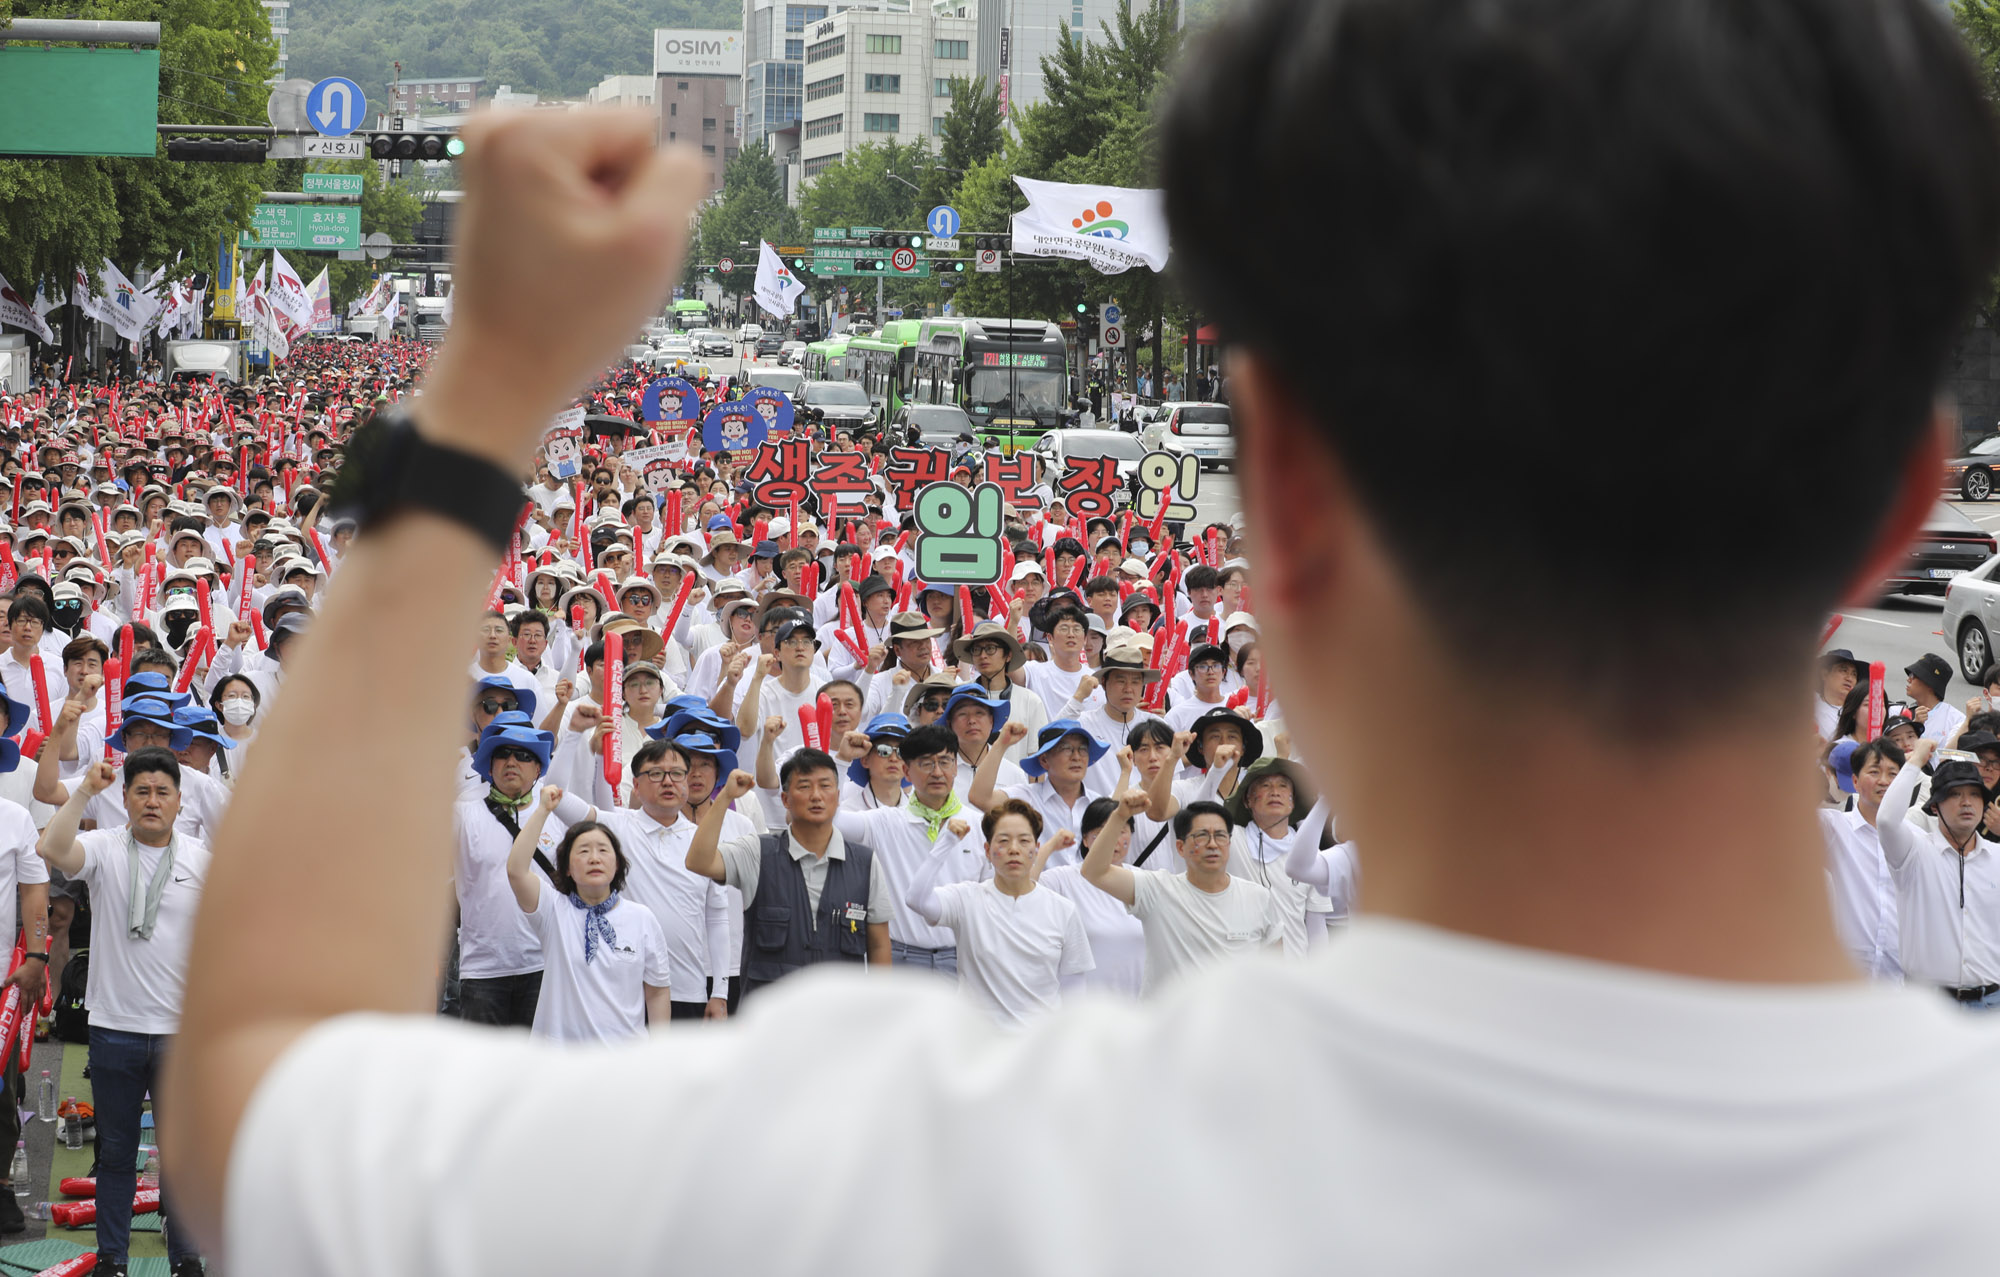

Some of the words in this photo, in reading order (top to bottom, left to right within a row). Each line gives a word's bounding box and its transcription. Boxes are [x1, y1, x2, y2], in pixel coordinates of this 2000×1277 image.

[665, 39, 721, 55] OSIM
[322, 142, 359, 155] 신호시
[306, 178, 360, 190] 정부서울청사
[254, 208, 286, 219] 수색역
[313, 212, 347, 224] 효자동
[252, 218, 278, 226] Susaek
[280, 218, 293, 226] Stn
[308, 224, 350, 234] Hyoja-dong
[816, 229, 846, 238] 경복궁역
[935, 241, 957, 249] 신호시
[897, 253, 912, 265] 50
[984, 253, 993, 261] 40
[983, 352, 999, 366] 1711
[1140, 454, 1198, 518] 인
[919, 485, 999, 579] 임
